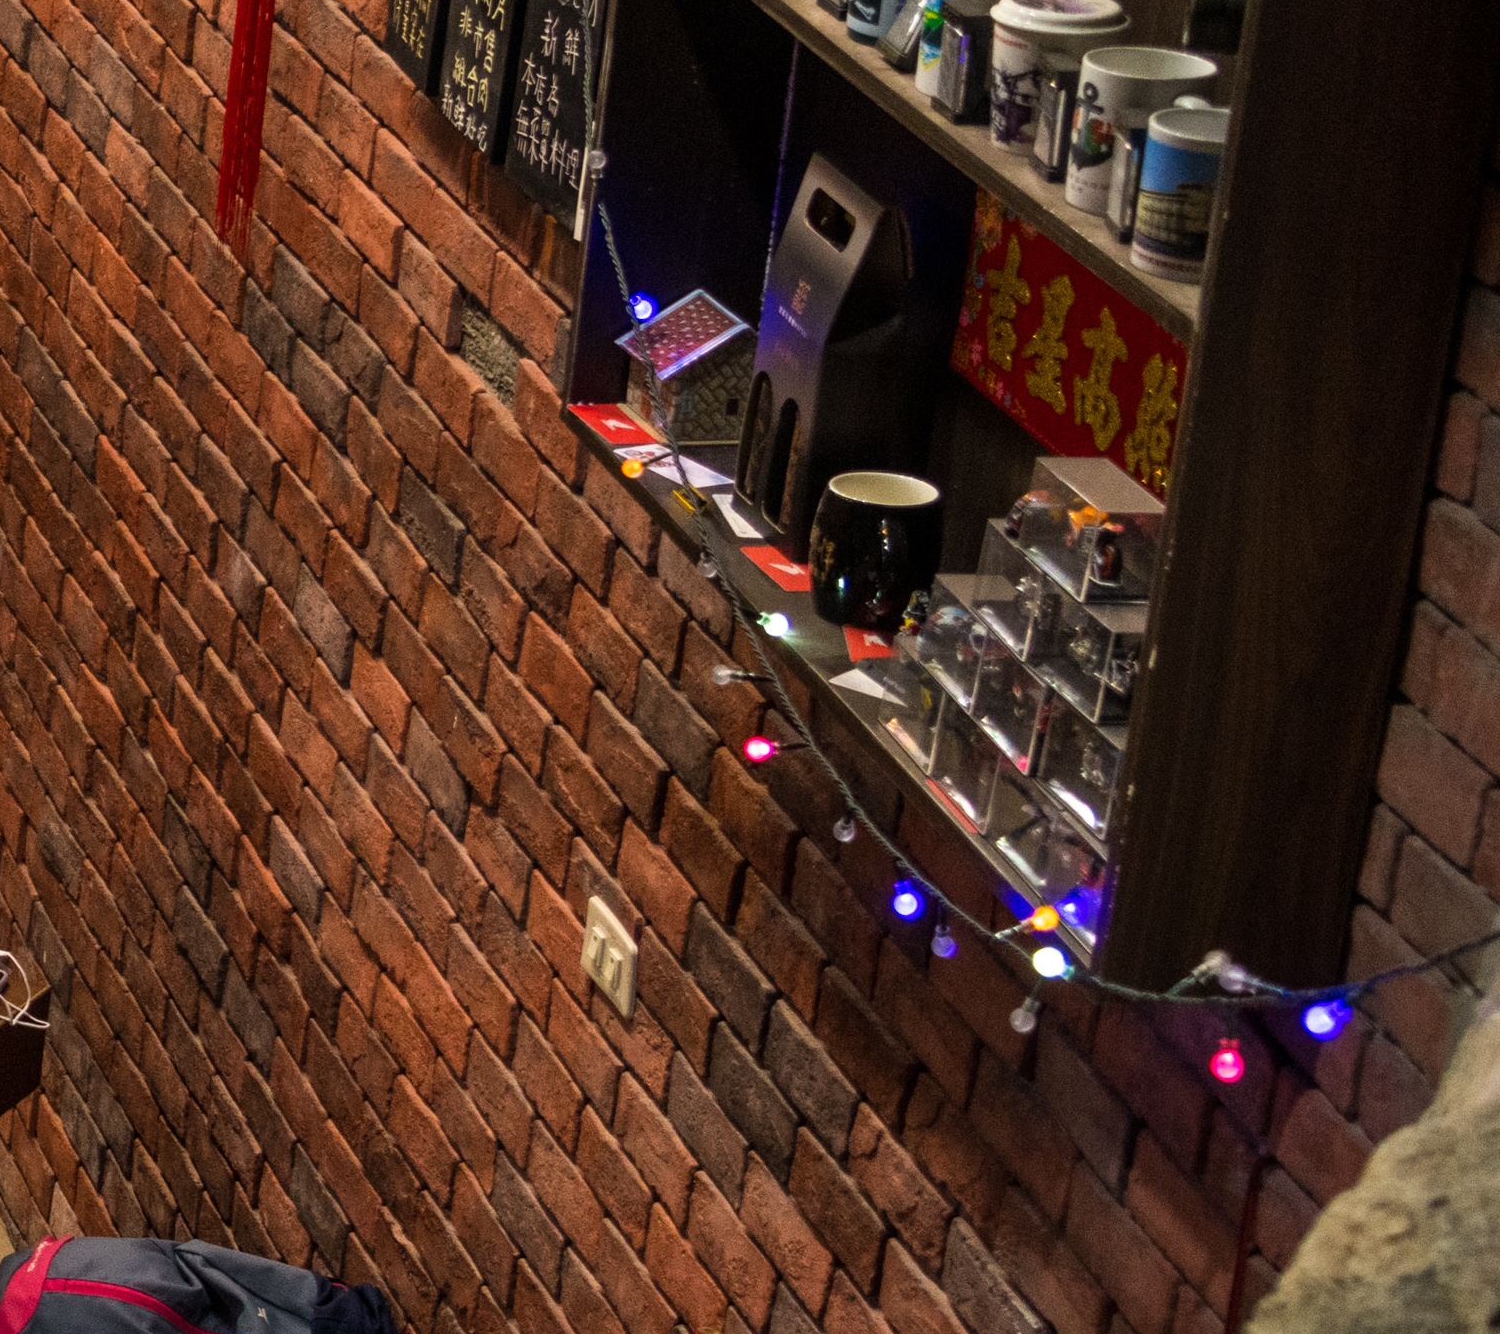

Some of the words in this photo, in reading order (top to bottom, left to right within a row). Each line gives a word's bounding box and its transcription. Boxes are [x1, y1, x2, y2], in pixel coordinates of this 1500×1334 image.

[541, 10, 579, 75] 新鮮
[521, 52, 559, 117] 本店為
